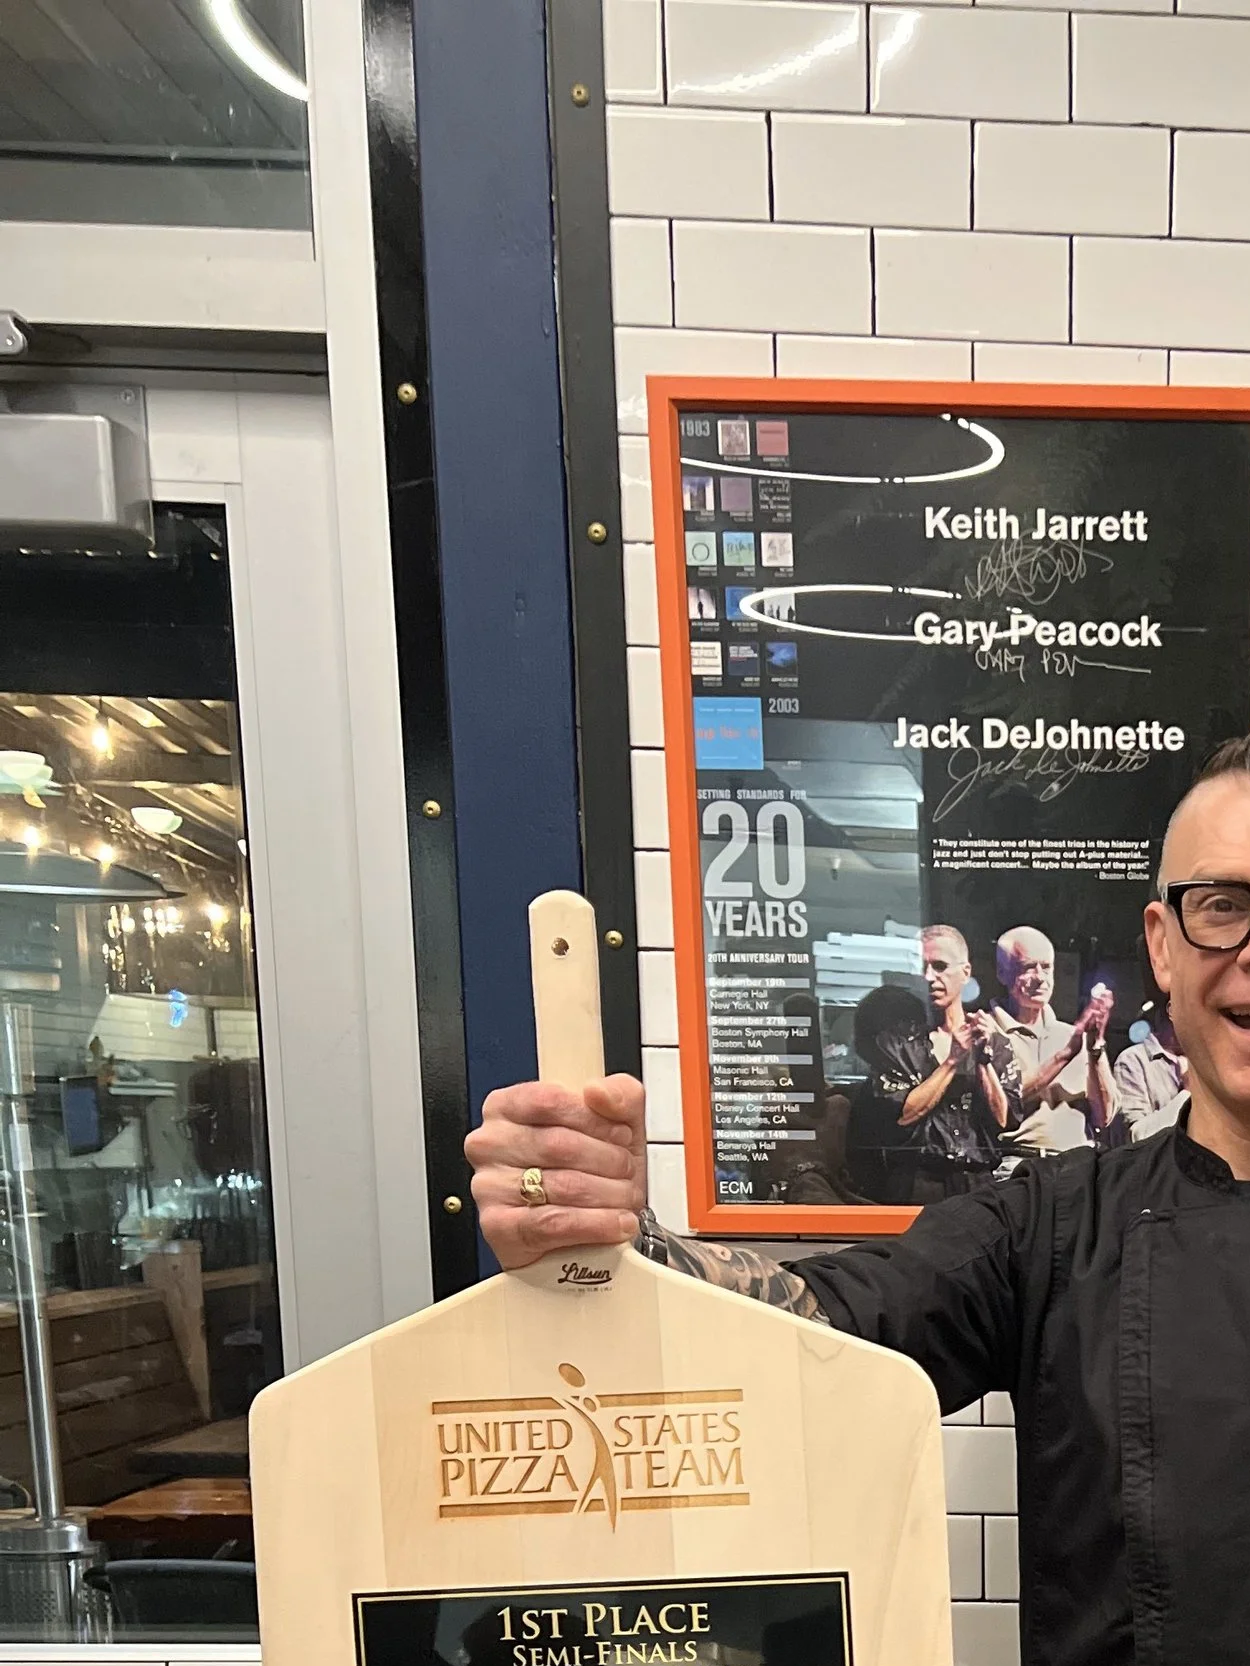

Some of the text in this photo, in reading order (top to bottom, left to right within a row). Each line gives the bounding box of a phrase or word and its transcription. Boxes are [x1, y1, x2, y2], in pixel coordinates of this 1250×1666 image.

[924, 506, 1148, 541] Keith Jarrett
[914, 612, 1162, 650] Gary Peacock
[768, 698, 799, 713] 2003
[893, 717, 1185, 751] Jack DeJohnette
[697, 789, 807, 800] SETTING STANDARDS FOR
[702, 800, 806, 899] 20
[959, 839, 999, 848] constitute
[1001, 840, 1017, 848] one
[1018, 839, 1027, 848] of
[1028, 839, 1042, 848] the
[1043, 839, 1066, 848] finest
[1067, 839, 1085, 848] trios
[1087, 840, 1095, 848] in
[1097, 840, 1110, 848] the
[1111, 840, 1138, 850] history
[1140, 840, 1149, 848] of
[933, 850, 950, 859] jazz
[953, 850, 968, 858] and
[970, 850, 986, 859] just
[1011, 850, 1029, 859] stop
[1031, 851, 1060, 860] putting
[1063, 850, 1076, 858] out
[1079, 851, 1105, 860] A-plus
[942, 860, 990, 870] magnificent
[1032, 861, 1059, 870] Maybe
[1061, 861, 1074, 869] the
[1076, 861, 1101, 869] album
[1103, 861, 1111, 869] of
[1112, 861, 1125, 869] the
[1100, 872, 1149, 880] Boston Globe
[705, 900, 808, 937] YEARS
[708, 953, 809, 963] 20TH ANNIVERSARY TOUR
[709, 989, 768, 999] Carnegie Hall
[711, 1028, 808, 1039] Boston Symphony Hall
[747, 1040, 762, 1048] MA
[713, 1066, 768, 1074] Masonic Hall
[713, 1077, 793, 1086] San Francisco, CA
[714, 1092, 763, 1101] November
[715, 1104, 800, 1113] Disney Concert Hall
[733, 1116, 770, 1125] Angeles,
[773, 1116, 787, 1124] CA
[716, 1130, 764, 1138] November
[717, 1141, 776, 1151] Benaroya Hall
[717, 1153, 768, 1162] Seattle, WA
[720, 1182, 753, 1194] ECM
[437, 1411, 741, 1454] UNITED STATES
[440, 1447, 745, 1497] PIZZA TEAM
[497, 1602, 711, 1641] 1ST PLACE
